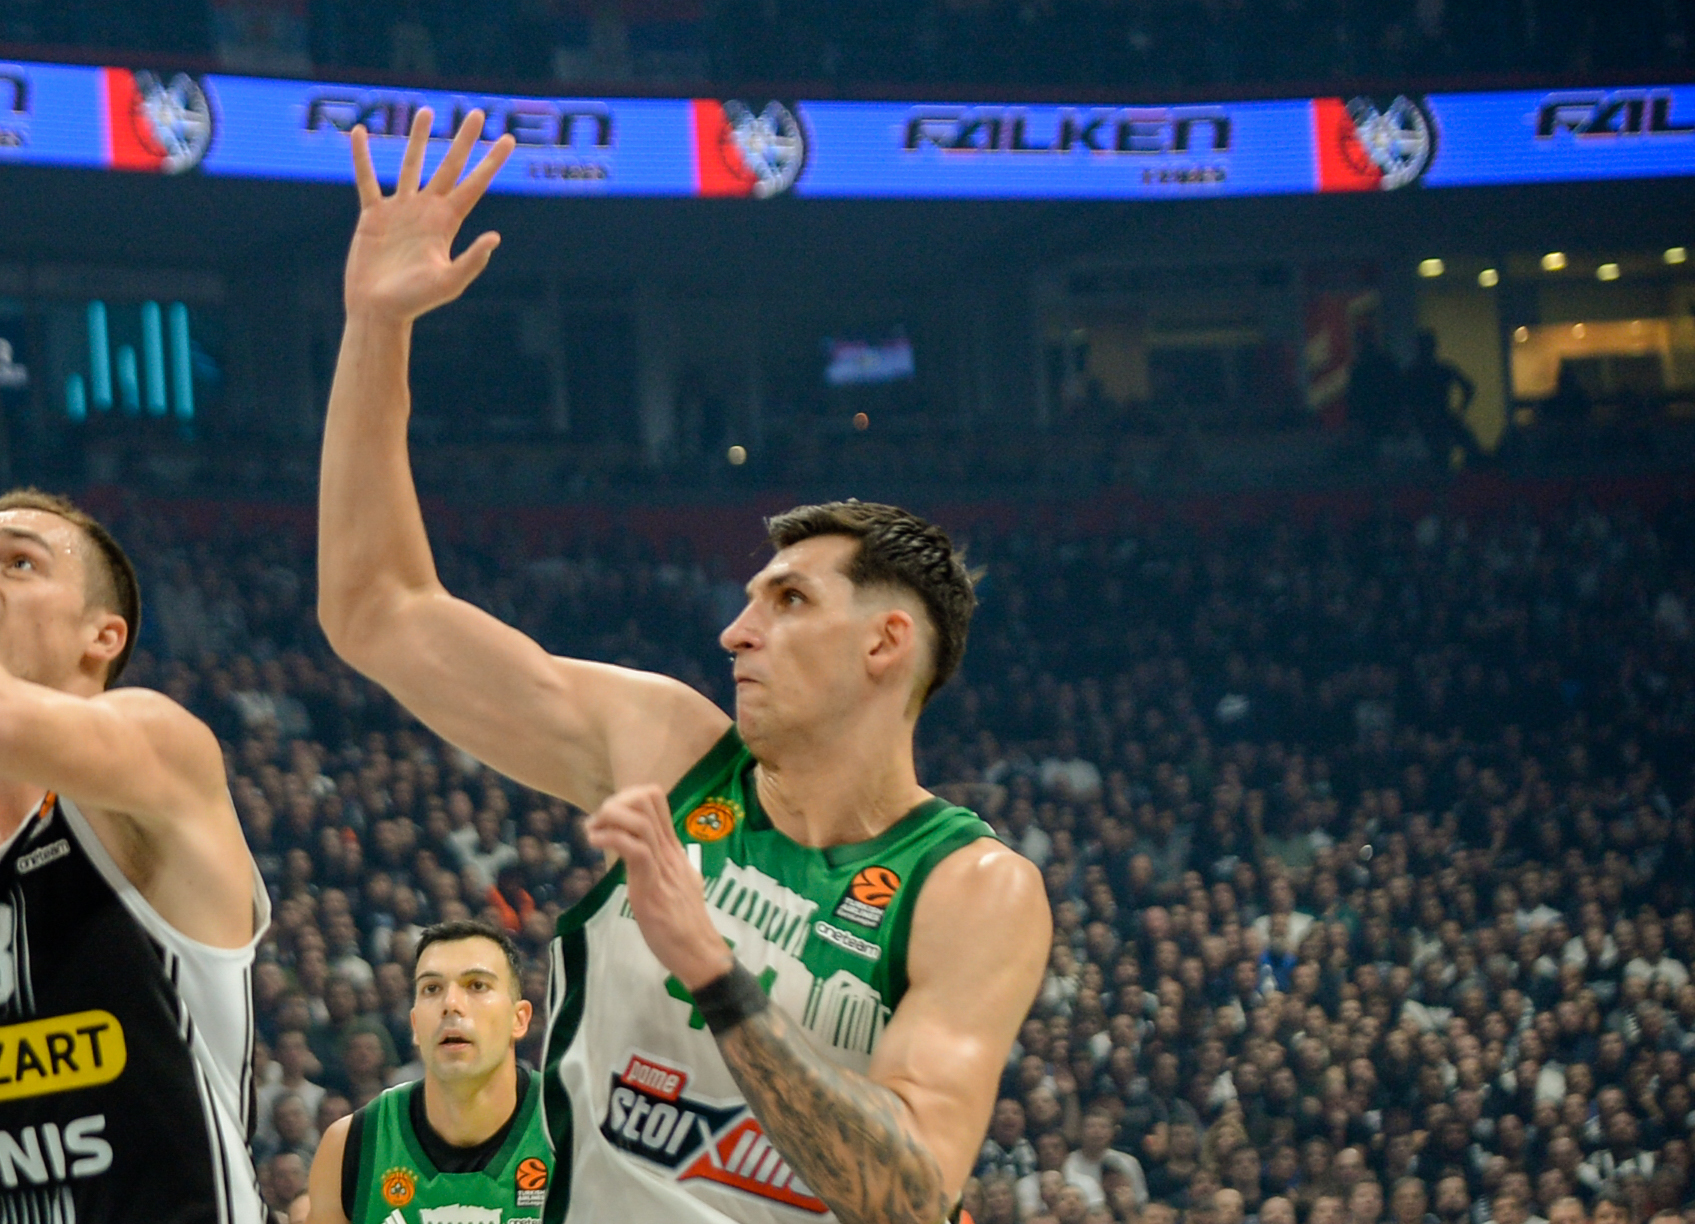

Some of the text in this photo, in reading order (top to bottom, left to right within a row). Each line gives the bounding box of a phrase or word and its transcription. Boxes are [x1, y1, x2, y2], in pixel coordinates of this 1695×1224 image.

[904, 106, 1231, 154] FALKEN
[1535, 89, 1695, 140] FAL
[626, 1060, 680, 1094] pame
